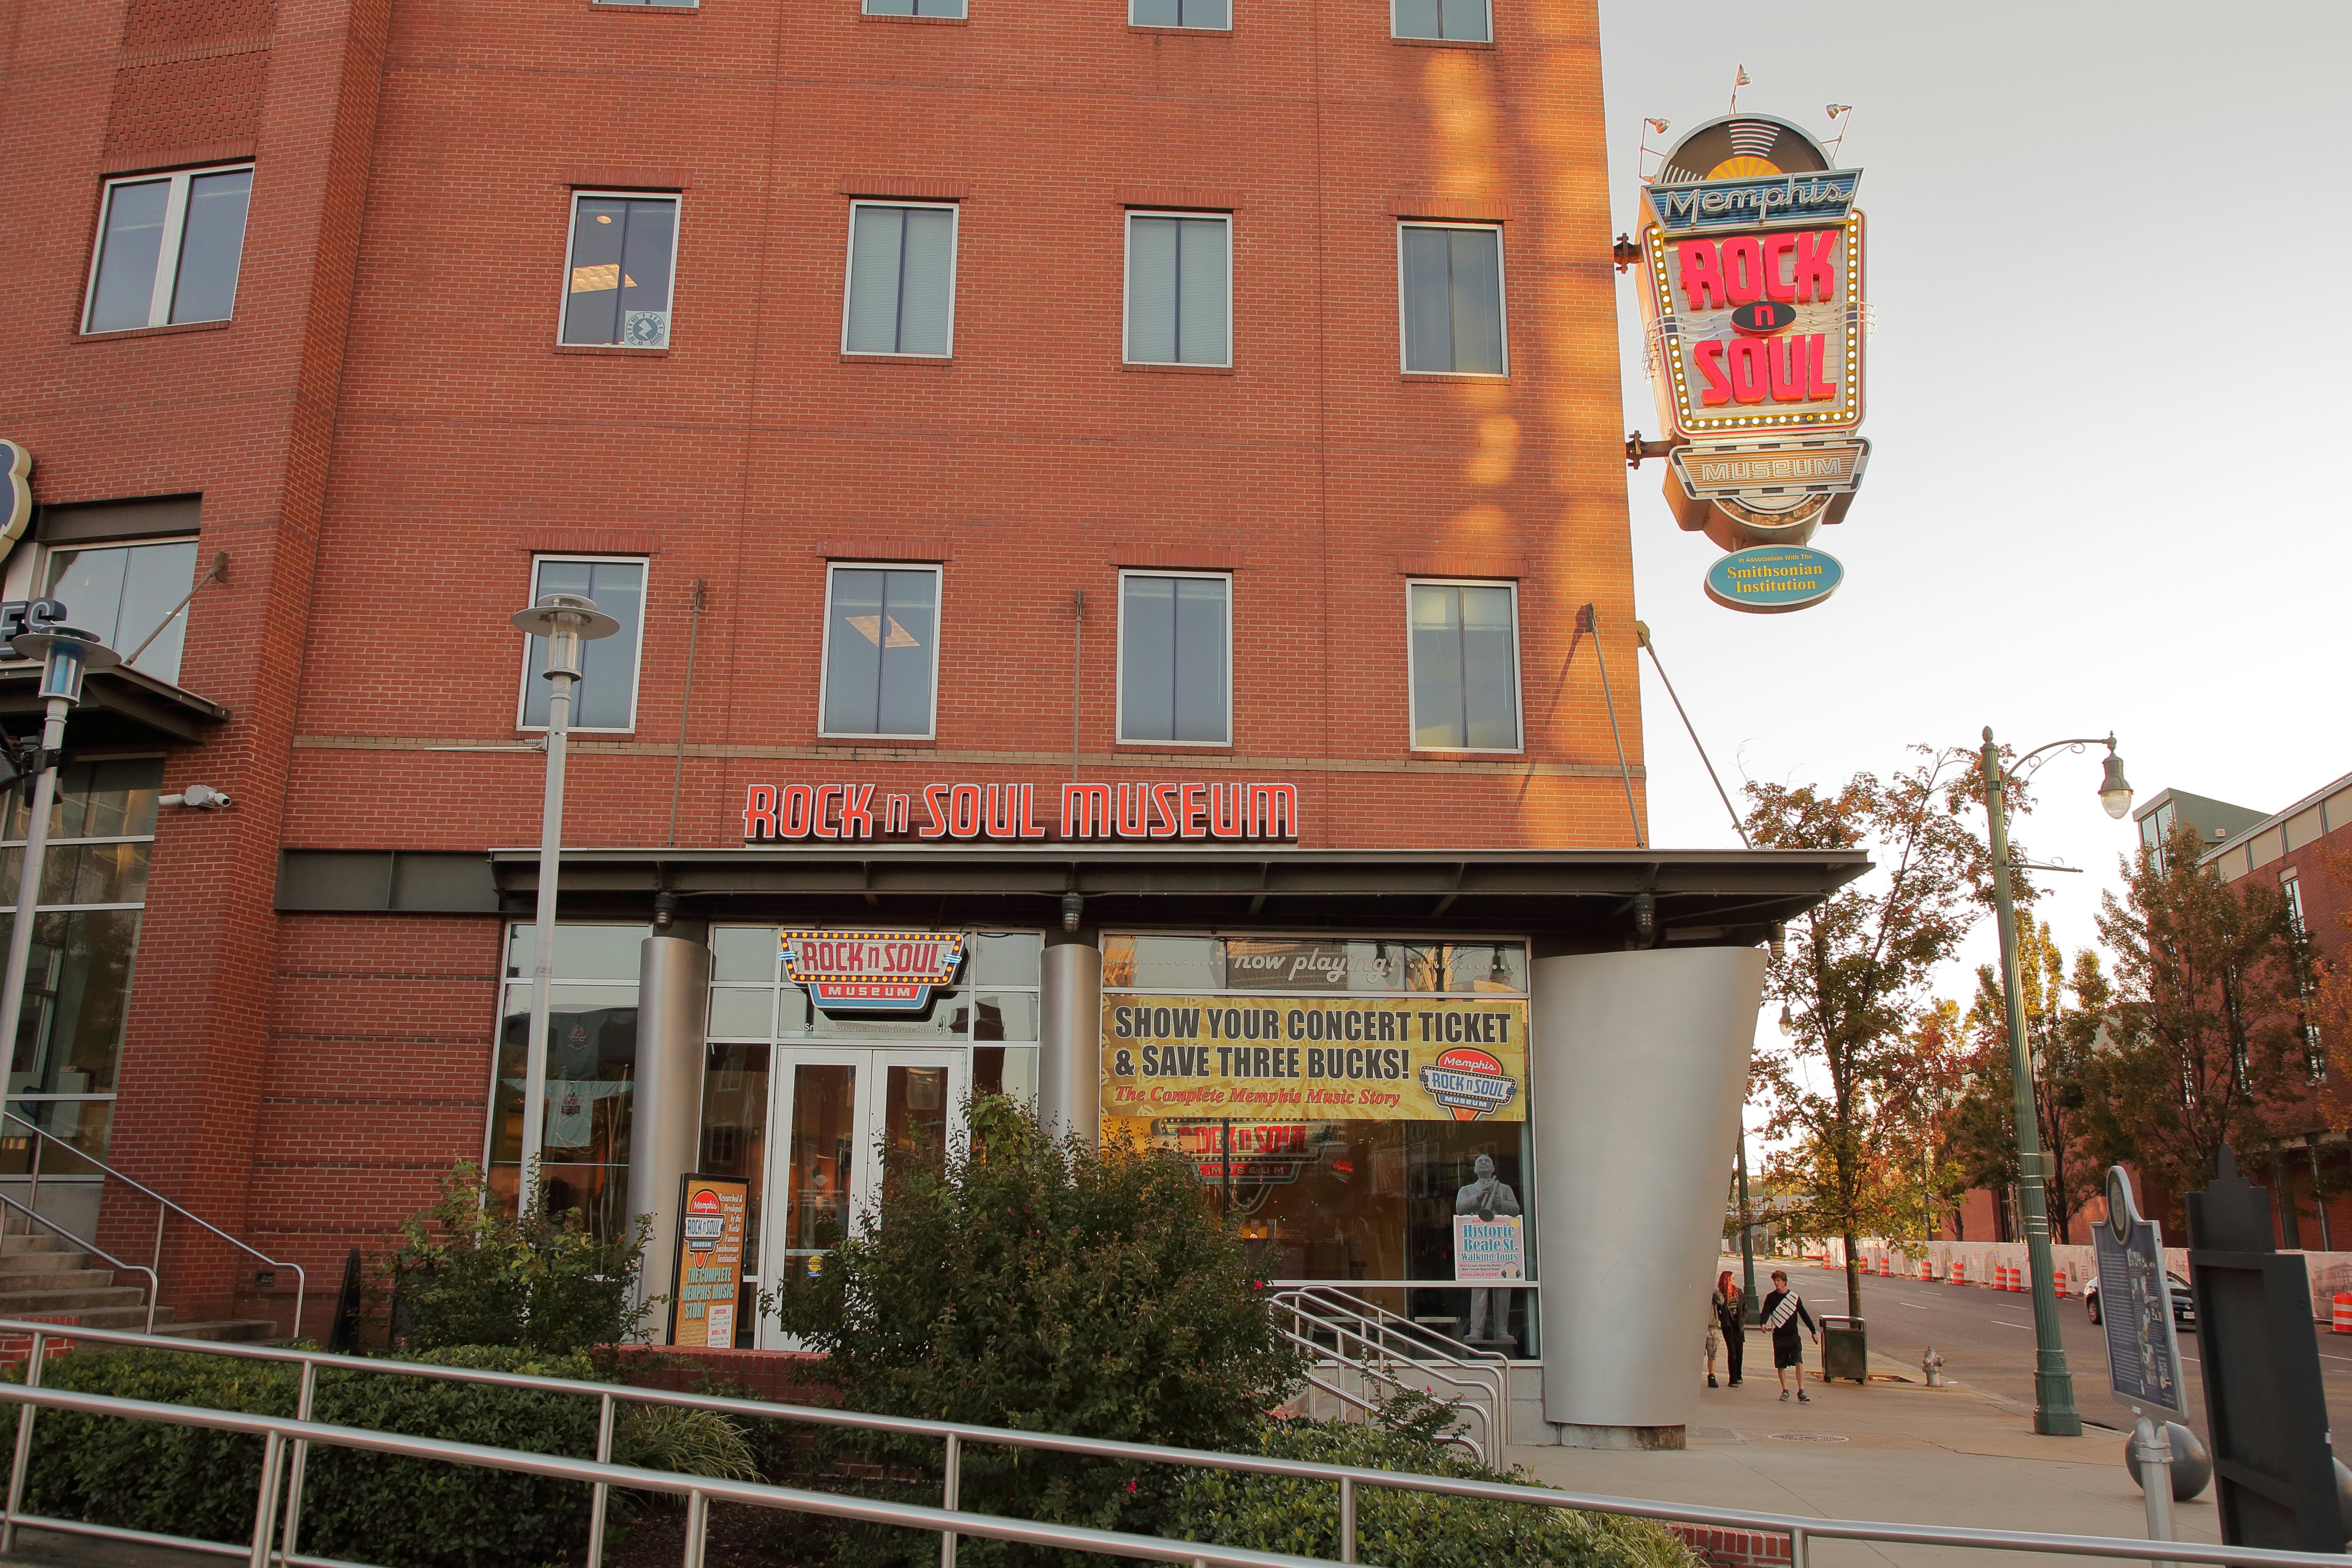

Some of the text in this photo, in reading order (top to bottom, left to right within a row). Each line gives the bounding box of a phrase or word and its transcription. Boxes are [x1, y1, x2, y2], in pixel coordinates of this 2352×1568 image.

[1665, 173, 1852, 226] Memphis
[1678, 231, 1839, 309] ROCK
[1754, 305, 1774, 326] n
[1694, 333, 1837, 405] SOUL
[1701, 457, 1841, 481] MUSEUM
[1727, 563, 1823, 579] Smithsonian
[1736, 578, 1816, 593] Institution
[742, 782, 1298, 839] ROCK n SOUL MUSEUM
[802, 942, 941, 973] ROCK n SOUL
[1235, 947, 1397, 983] now playing!
[828, 985, 910, 997] MUSEUM
[805, 1023, 862, 1032] Smithsonian
[867, 1024, 912, 1033] Institution
[916, 1025, 952, 1033] Affiliate
[1115, 1006, 1511, 1044] SHOW YOUR CONCERT TICKET
[1114, 1045, 1410, 1081] & SAVE THREE BUCKS!
[1444, 1056, 1497, 1071] Memphis
[1432, 1072, 1504, 1097] ROCK n SOUL
[1115, 1086, 1400, 1109] The Complete Memphis Music Story
[1445, 1096, 1487, 1107] MUSEUM
[1239, 1129, 1252, 1151] n
[1254, 1126, 1309, 1153] SOUL
[719, 1193, 742, 1202] Researched &
[694, 1200, 717, 1213] Memphis
[724, 1204, 742, 1214] Developed
[688, 1219, 720, 1235] ROCK n SOUL
[730, 1214, 735, 1224] by
[728, 1224, 740, 1232] World-
[1463, 1224, 1515, 1238] Historic
[725, 1234, 739, 1242] Famous
[1463, 1238, 1518, 1251] Beale St.
[716, 1244, 739, 1252] Smithsonian
[717, 1254, 738, 1263] Institution!
[1461, 1252, 1518, 1261] Walking Tours
[688, 1267, 732, 1283] THE COMPLETE
[682, 1284, 734, 1301] MEMPHIS MUSIC
[685, 1302, 706, 1319] STORY
